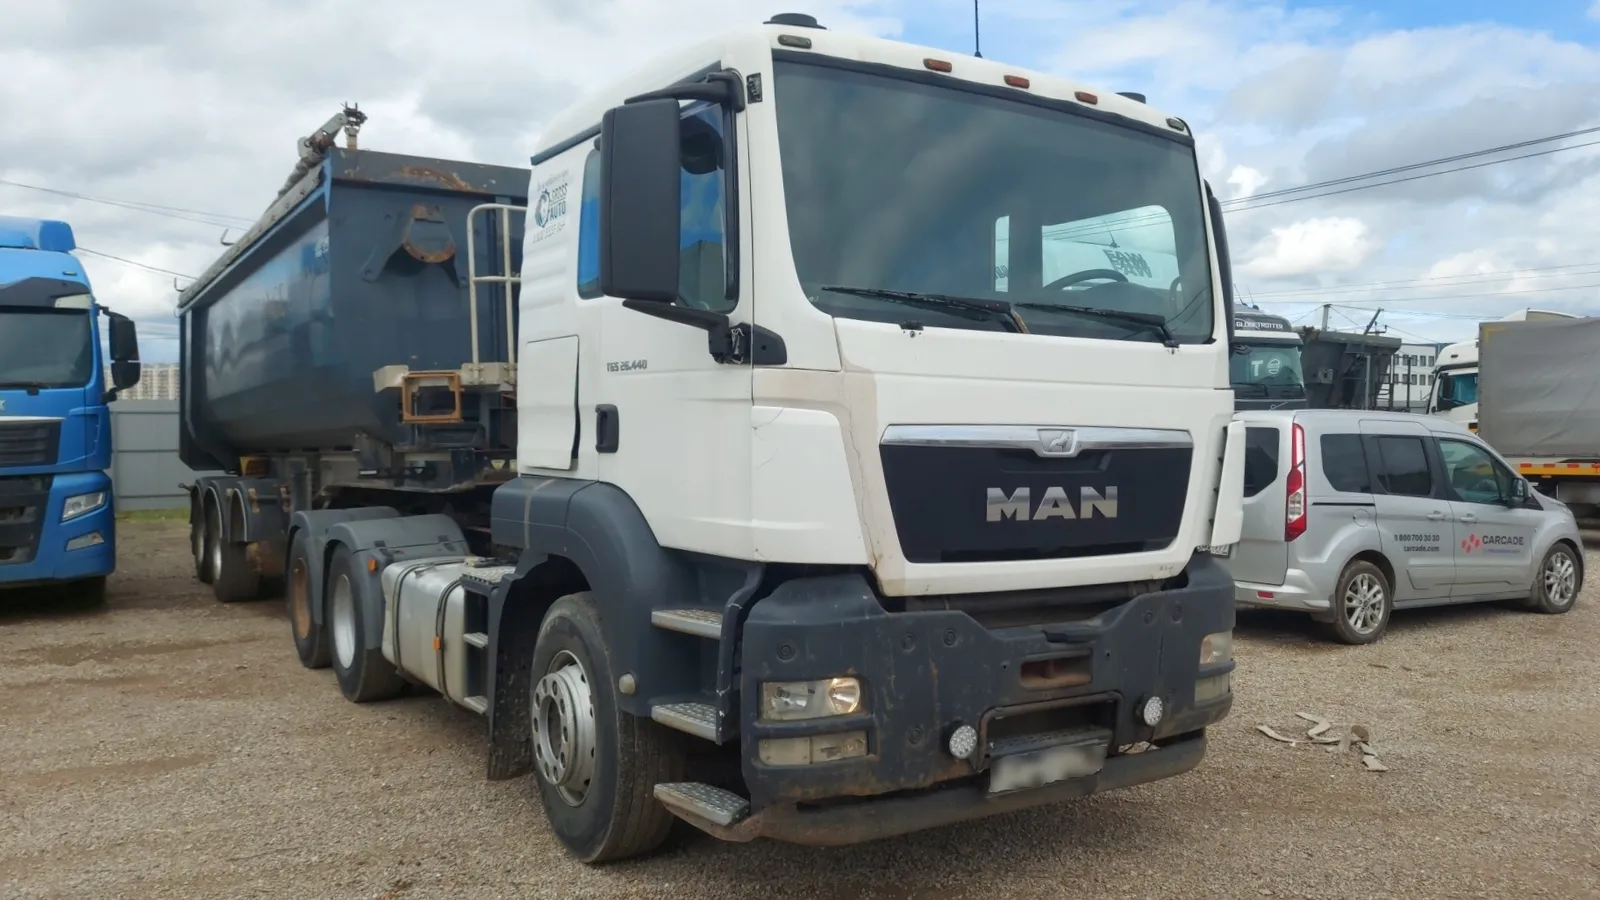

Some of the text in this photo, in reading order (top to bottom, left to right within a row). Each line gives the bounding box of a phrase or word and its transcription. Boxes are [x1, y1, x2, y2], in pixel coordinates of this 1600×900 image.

[550, 200, 566, 220] AUTO
[620, 359, 648, 371] 26.440
[986, 486, 1118, 522] MAN
[1411, 534, 1423, 542] 700
[1424, 534, 1431, 542] 30
[1432, 534, 1440, 542] 30
[1482, 535, 1525, 546] CARCADE
